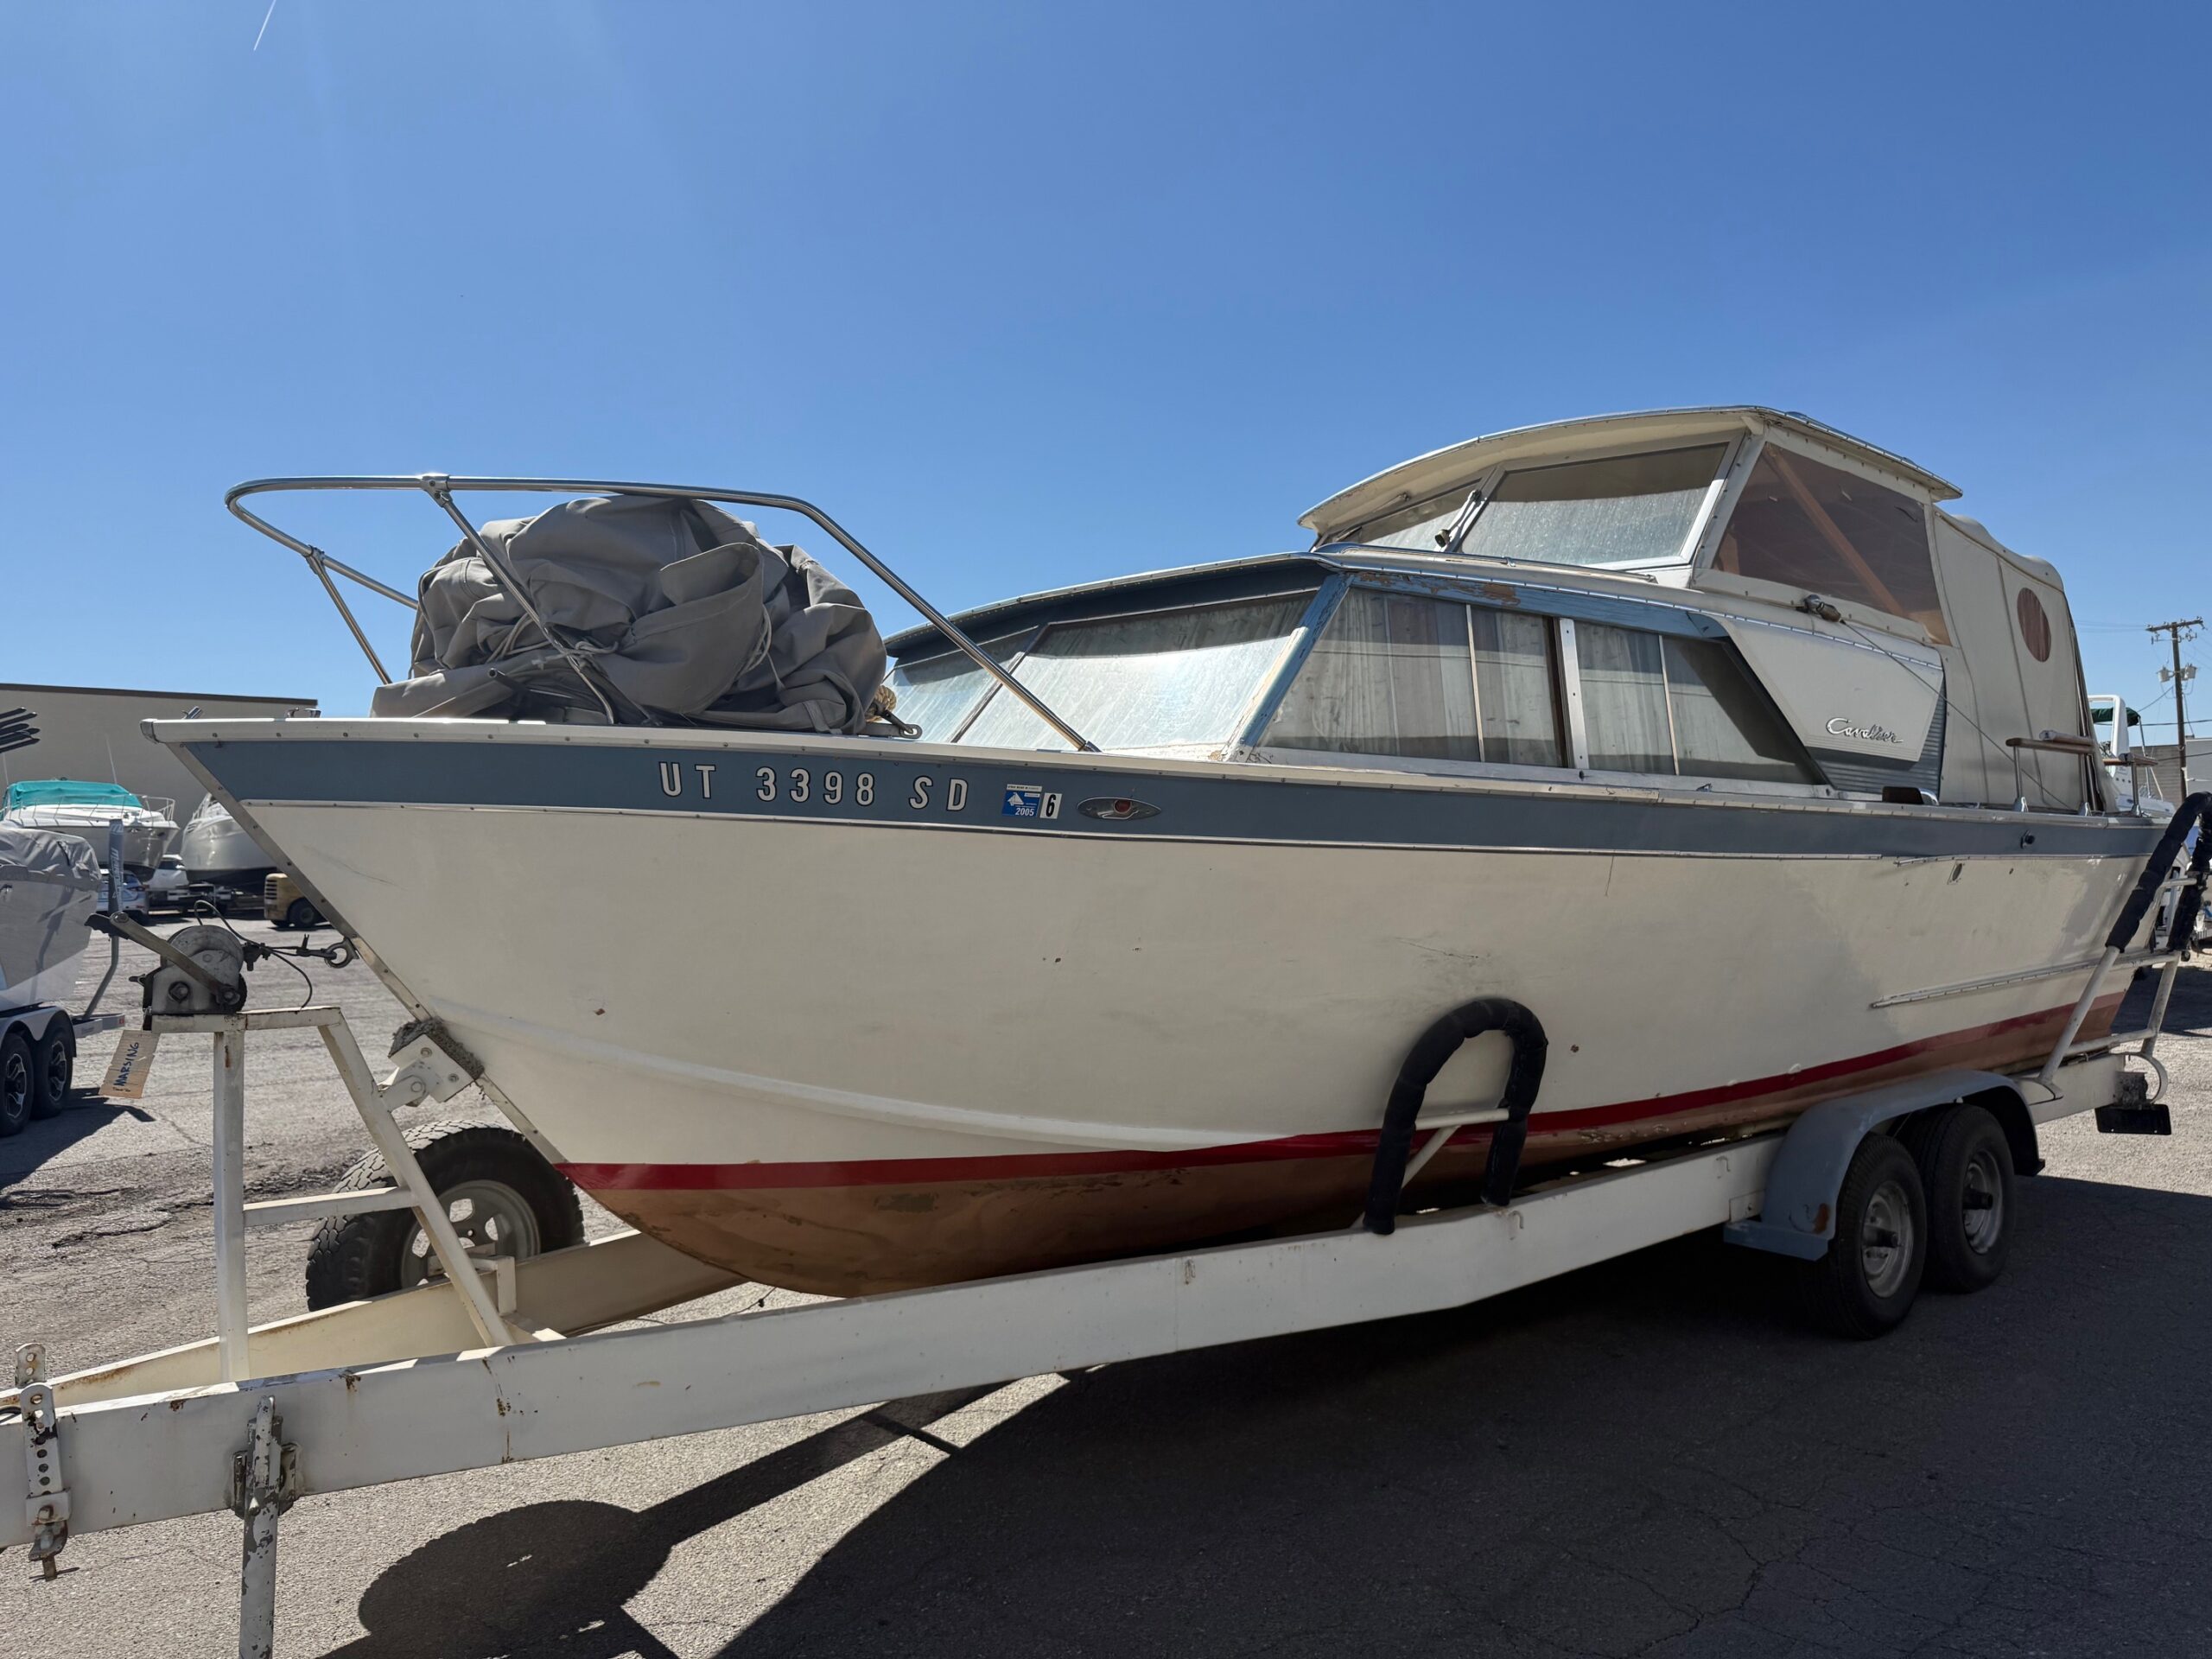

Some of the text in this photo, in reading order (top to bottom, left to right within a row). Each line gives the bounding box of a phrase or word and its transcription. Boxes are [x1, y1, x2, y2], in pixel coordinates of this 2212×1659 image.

[1826, 717, 1904, 743] Cavalier
[658, 761, 969, 811] UT 3398 SD
[1014, 807, 1035, 817] 2005
[1046, 793, 1057, 817] 6
[113, 1042, 139, 1086] MARSING
